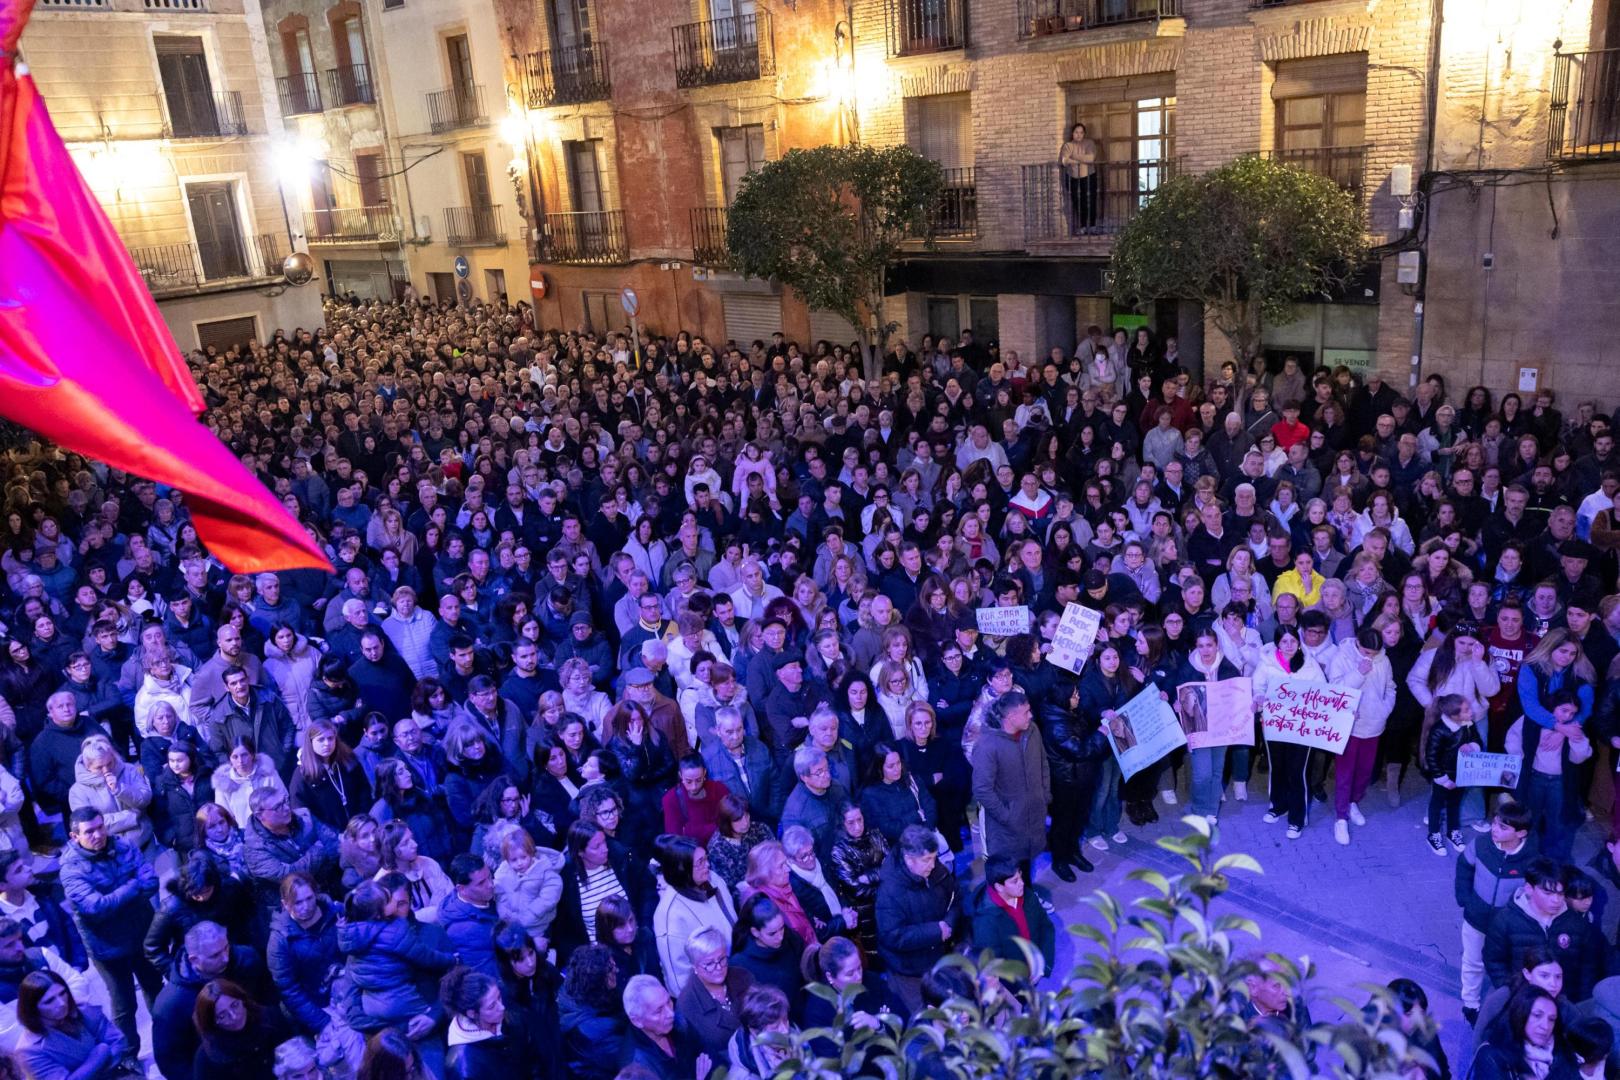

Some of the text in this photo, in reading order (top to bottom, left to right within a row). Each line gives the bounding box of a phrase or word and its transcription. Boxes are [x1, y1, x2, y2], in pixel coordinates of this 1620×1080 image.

[1344, 359, 1370, 367] VENDE
[1275, 682, 1354, 712] Ser diferente
[1265, 702, 1283, 713] no
[1297, 721, 1310, 736] la
[1314, 726, 1342, 742] vida
[1464, 760, 1516, 770] EL QUE NO
